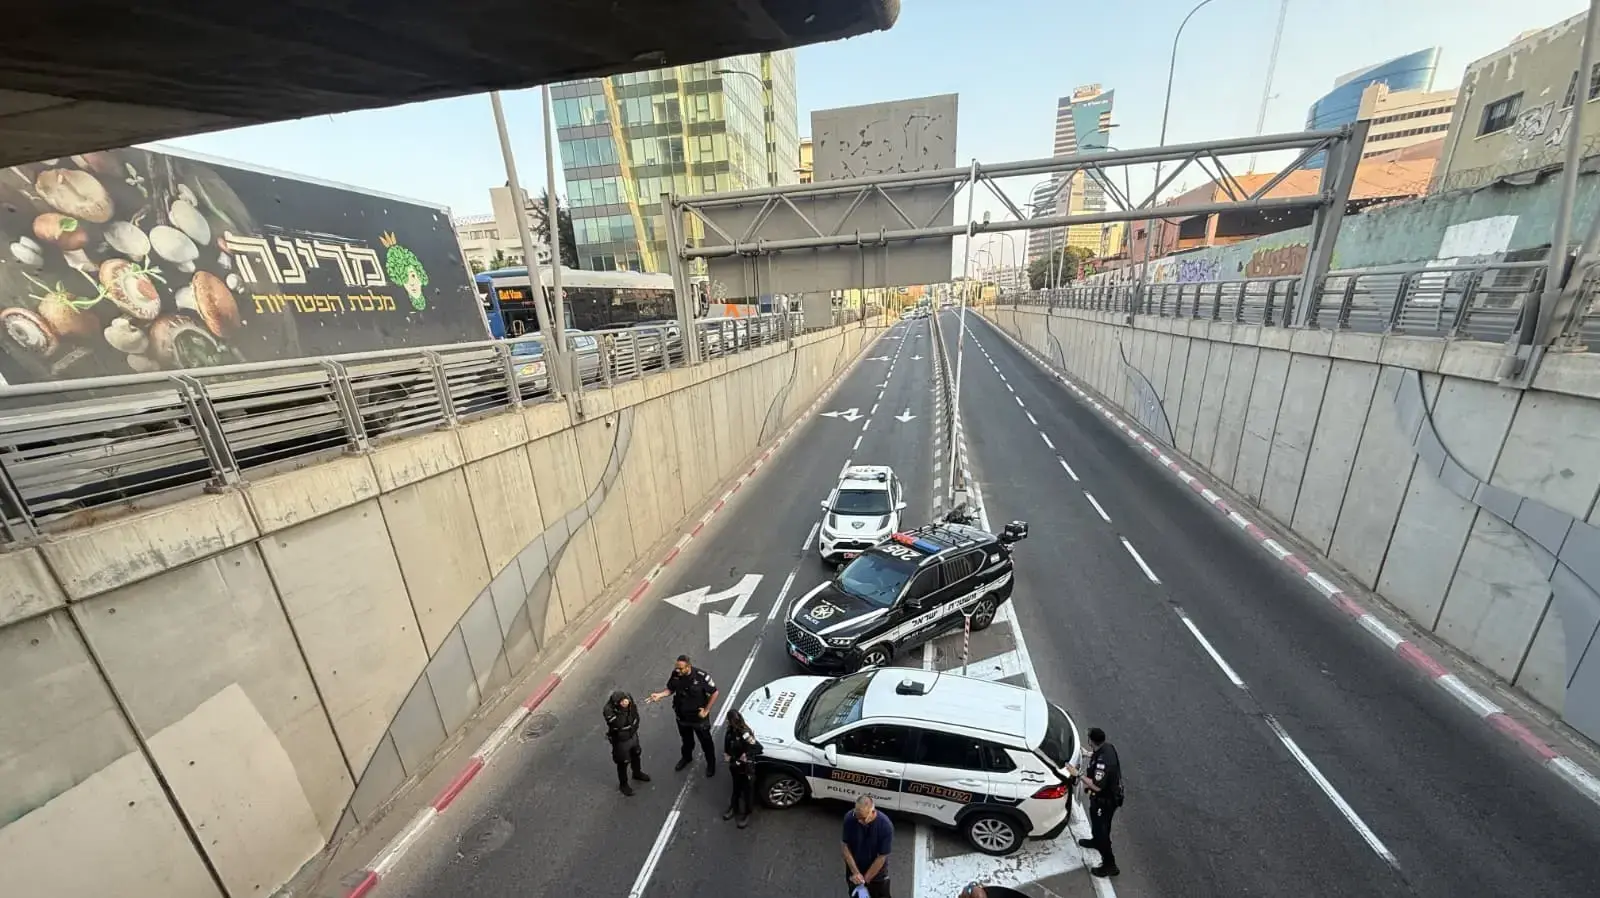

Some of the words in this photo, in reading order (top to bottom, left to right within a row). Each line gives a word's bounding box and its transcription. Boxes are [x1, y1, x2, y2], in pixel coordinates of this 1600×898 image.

[224, 231, 386, 287] מרינה
[252, 293, 345, 314] הפטריות
[347, 289, 397, 312] מלכת
[883, 545, 922, 561] 205
[911, 610, 938, 627] ישראל
[768, 691, 788, 718] התנועה
[777, 691, 796, 719] משטרת
[831, 769, 888, 788] התנועה
[826, 785, 856, 796] POLICE
[908, 782, 973, 803] משטרת
